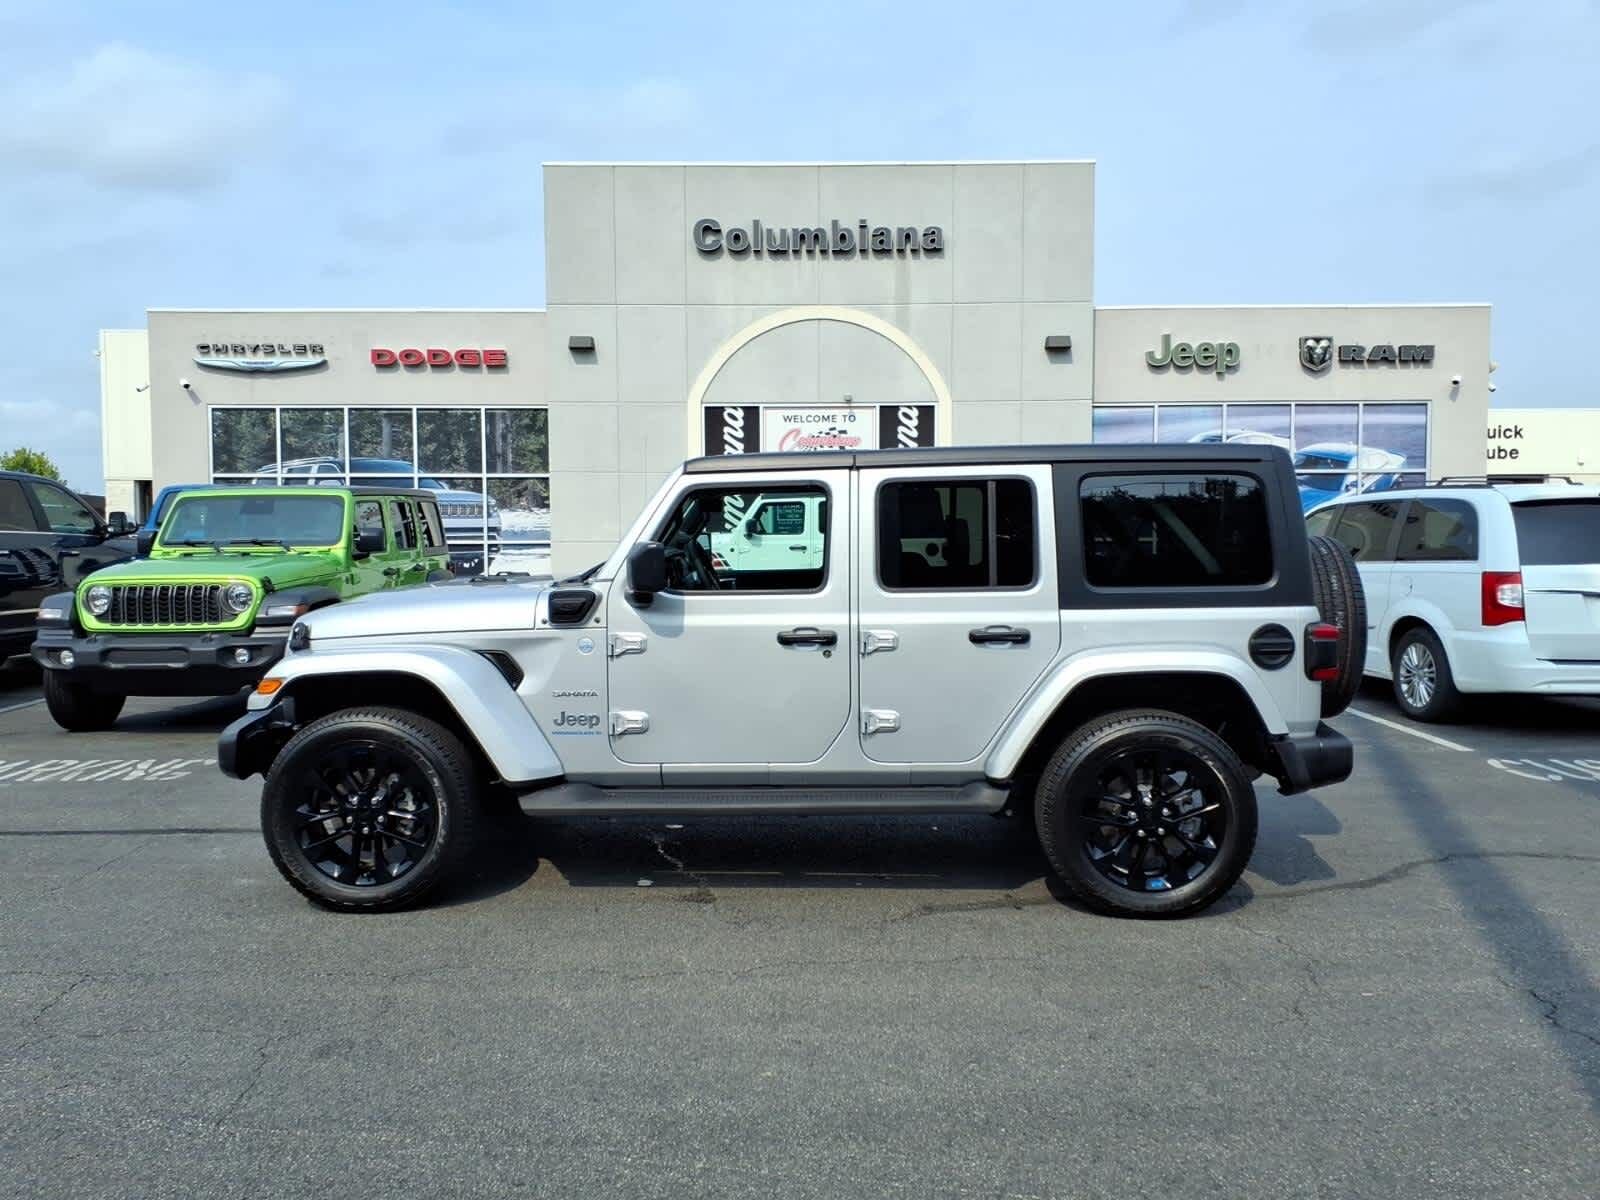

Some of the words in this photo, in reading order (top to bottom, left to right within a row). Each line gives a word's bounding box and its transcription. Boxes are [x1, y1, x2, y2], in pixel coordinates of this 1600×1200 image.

[693, 218, 944, 252] Columbiana
[196, 343, 324, 354] CHRYSLER
[1145, 333, 1241, 373] Jeep
[1338, 344, 1435, 361] RAM
[370, 349, 507, 367] DODGE
[782, 414, 837, 423] WELCOME
[842, 414, 857, 423] TO
[1487, 424, 1524, 439] uick
[1486, 445, 1520, 460] ube
[553, 711, 601, 728] Jeep
